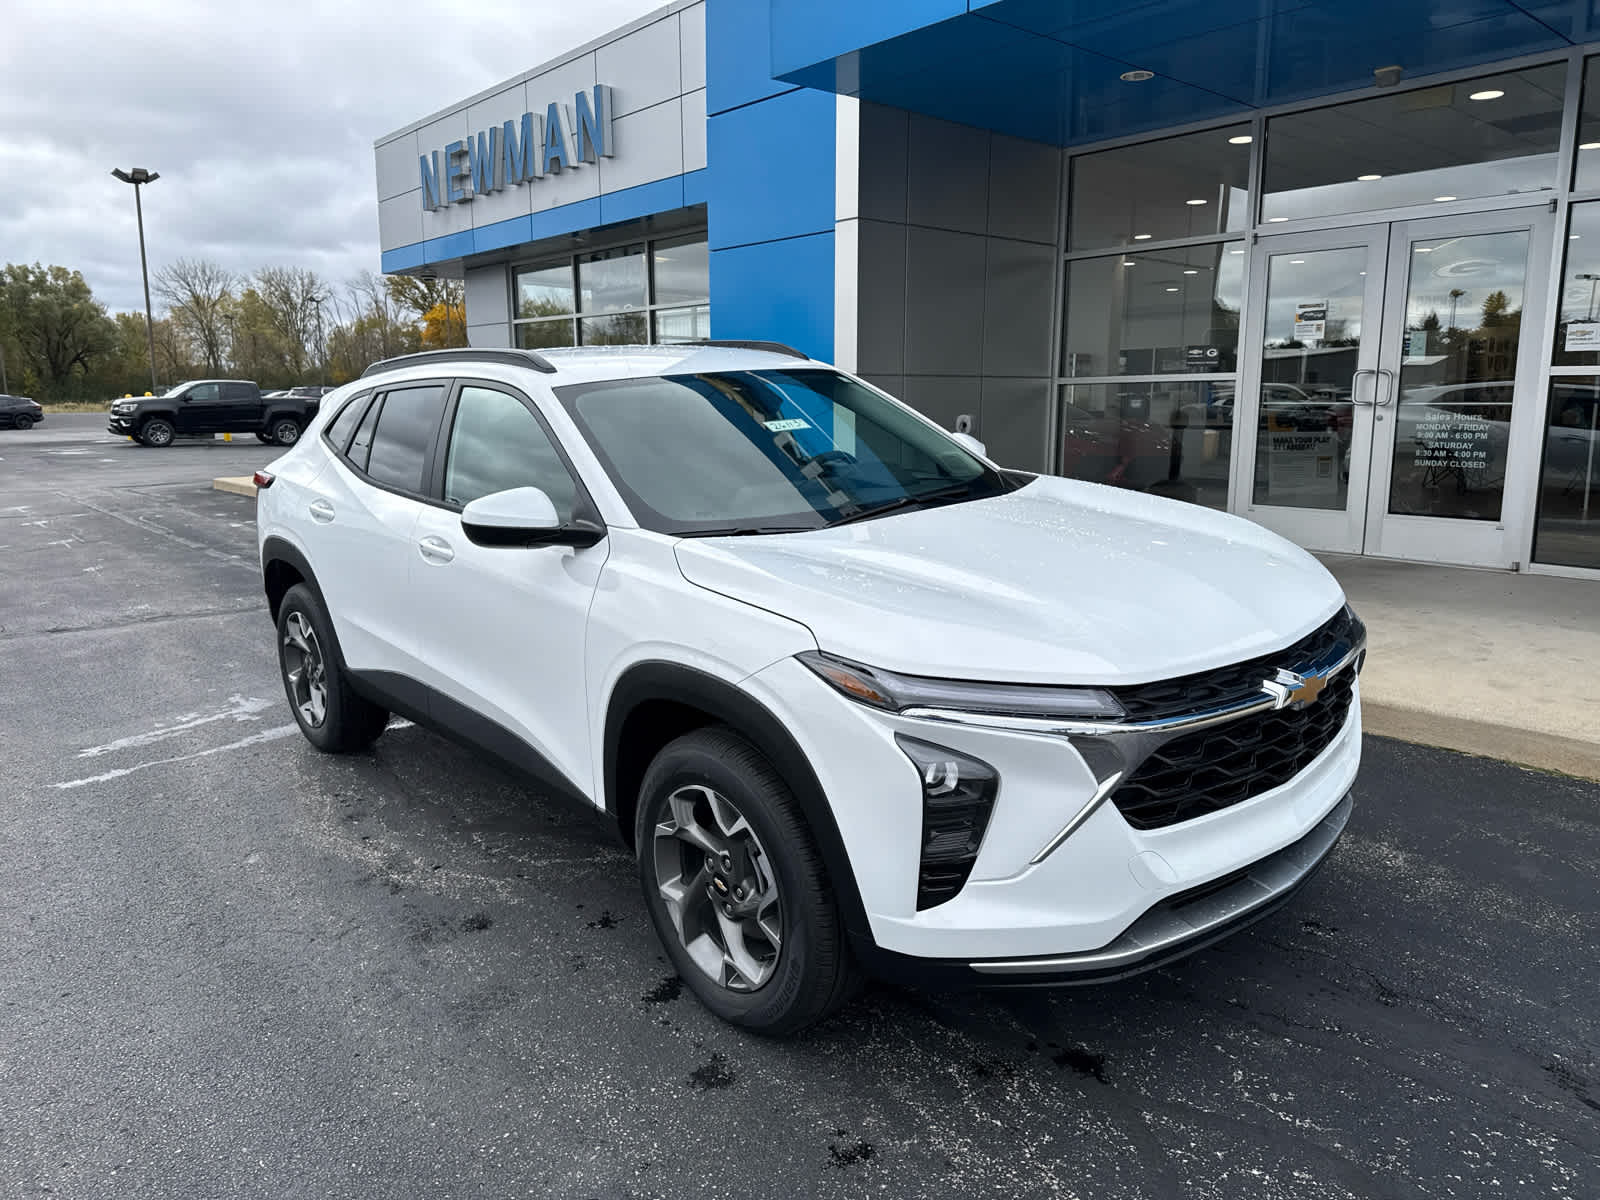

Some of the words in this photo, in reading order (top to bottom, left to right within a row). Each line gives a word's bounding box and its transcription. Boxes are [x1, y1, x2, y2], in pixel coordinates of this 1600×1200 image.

[420, 83, 614, 212] NEWMAN
[1424, 412, 1451, 421] Sales
[1453, 413, 1483, 421] Hours
[1415, 423, 1451, 431] MONDAY
[1428, 441, 1474, 449] SATURDAY
[1414, 459, 1448, 467] SUNDAY
[1449, 460, 1486, 469] CLOSED
